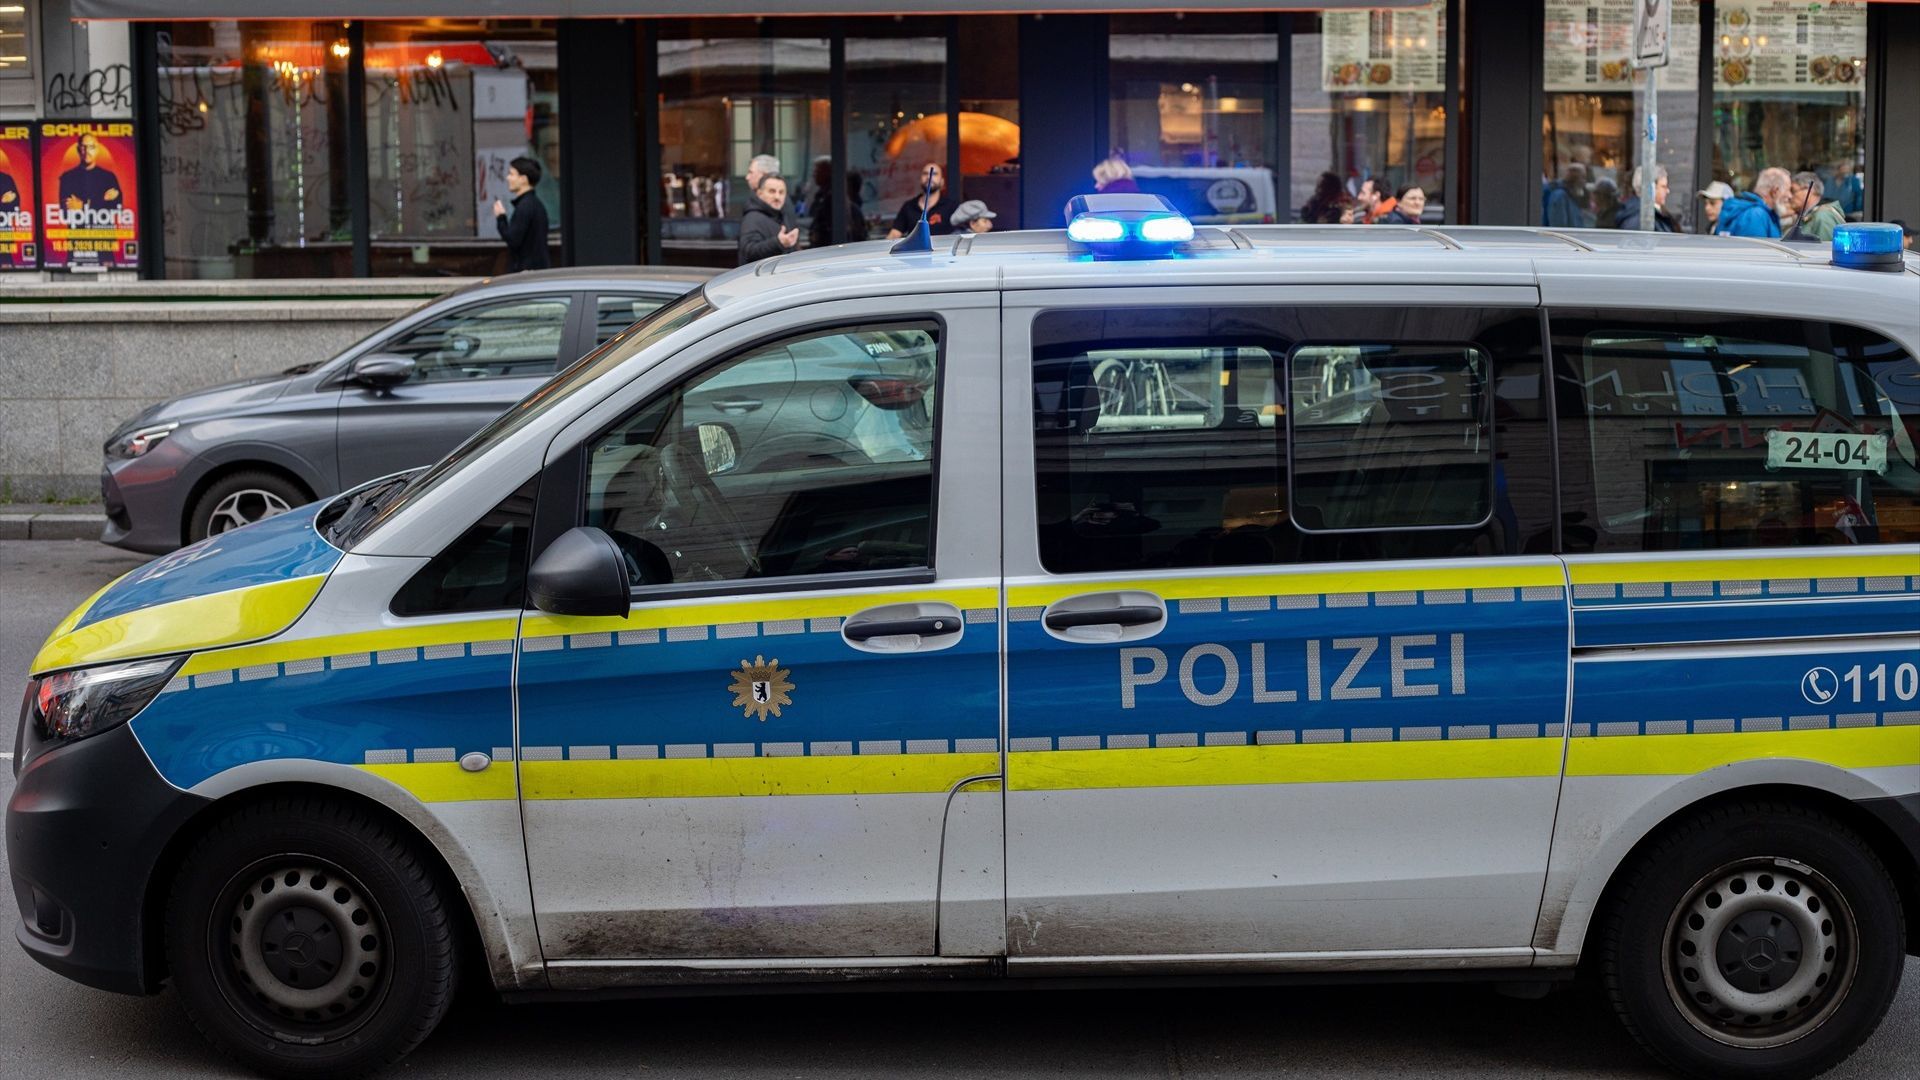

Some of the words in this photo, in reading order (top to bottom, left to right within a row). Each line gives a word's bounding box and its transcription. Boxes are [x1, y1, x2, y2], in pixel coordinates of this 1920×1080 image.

[42, 123, 134, 137] SCHILLER
[45, 203, 134, 229] Euphoria
[865, 342, 893, 355] FINN
[1785, 436, 1870, 465] 24-04
[1120, 633, 1466, 709] POLIZEI
[1844, 662, 1919, 703] 110
